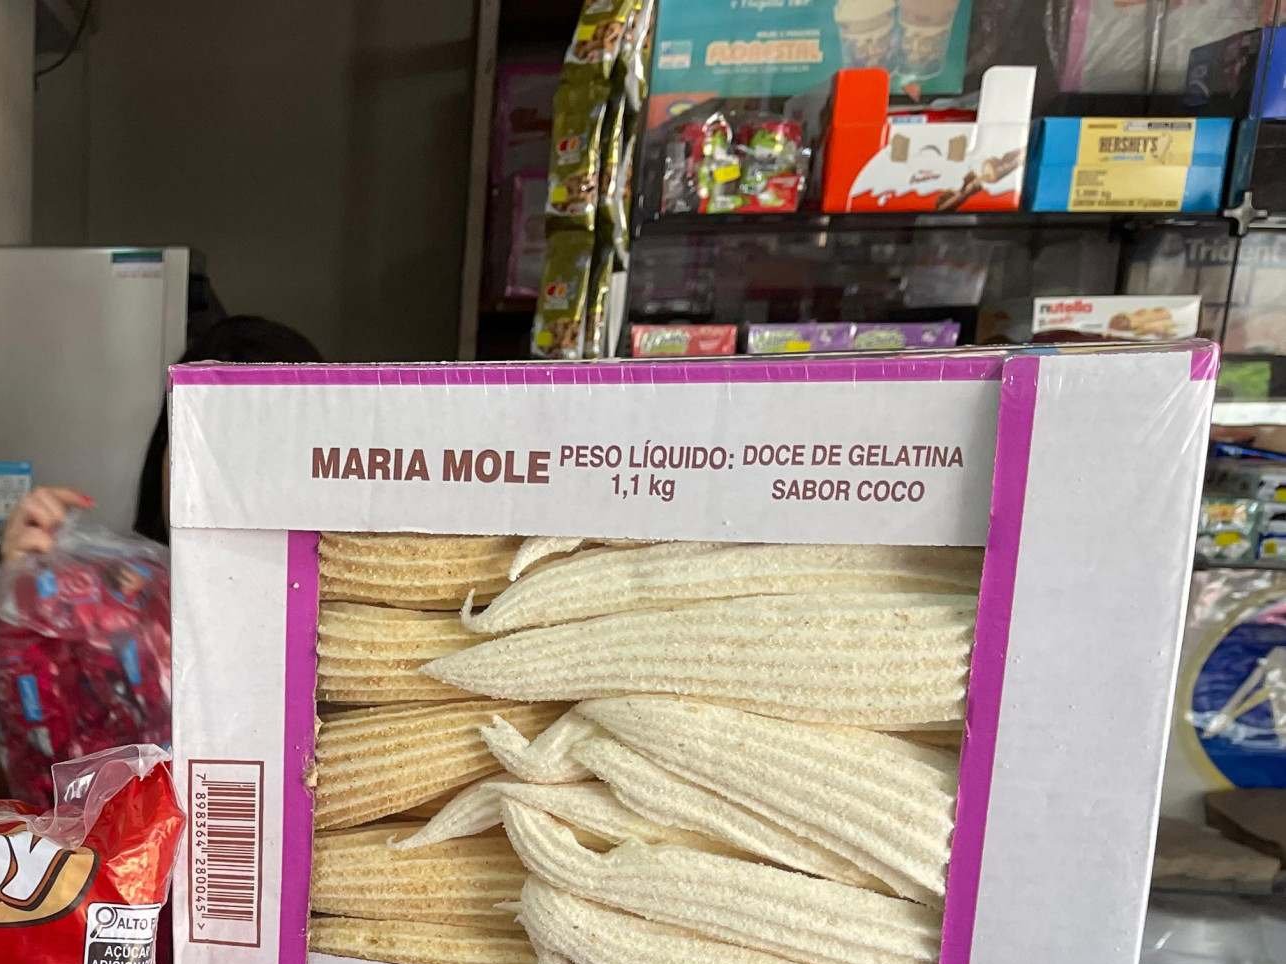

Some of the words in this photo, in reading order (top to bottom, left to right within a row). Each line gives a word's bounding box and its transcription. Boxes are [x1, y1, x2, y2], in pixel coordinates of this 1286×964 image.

[1098, 136, 1158, 153] HERSHEY'S
[1040, 300, 1093, 314] nutella
[311, 447, 429, 482] MARIA
[443, 450, 550, 485] MOLE
[560, 445, 622, 470] PESO
[629, 438, 734, 473] LÍQUIDO:
[743, 445, 803, 467] DOCE
[811, 445, 842, 467] DE
[849, 445, 963, 469] GELATINA
[612, 474, 641, 498] 1,1
[649, 474, 676, 502] kg
[772, 479, 850, 503] SABOR
[857, 479, 925, 503] COCO
[117, 918, 148, 932] ALTO
